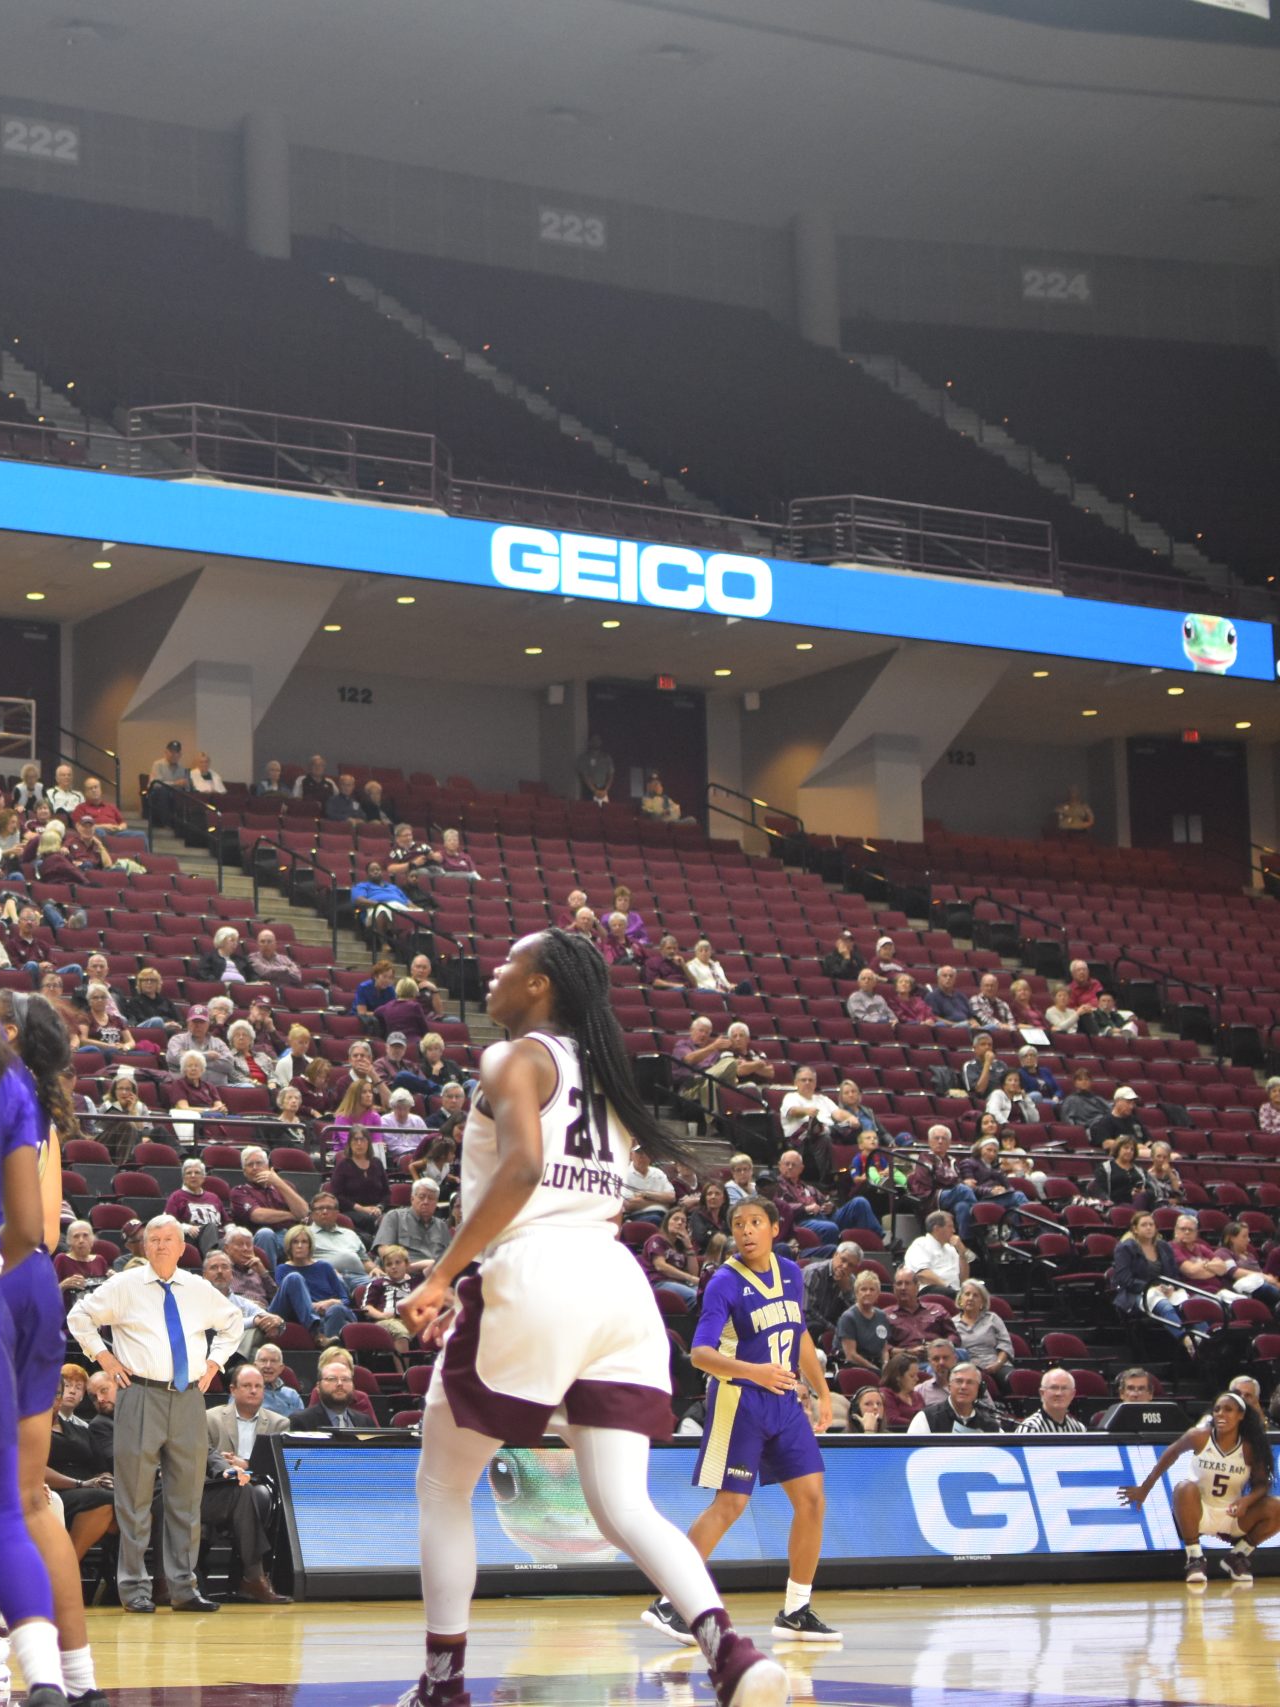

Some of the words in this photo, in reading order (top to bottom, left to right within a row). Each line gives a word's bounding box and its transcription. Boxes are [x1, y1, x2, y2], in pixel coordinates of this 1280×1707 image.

[4, 121, 78, 160] 222
[541, 211, 604, 246] 223
[1023, 269, 1090, 300] 224
[491, 525, 772, 618] GEICO
[337, 686, 373, 704] 122
[564, 1086, 614, 1163] 21
[768, 1329, 794, 1372] 12
[1142, 1413, 1162, 1424] POSS
[1198, 1459, 1227, 1472] TEXAS
[1211, 1473, 1230, 1498] 5
